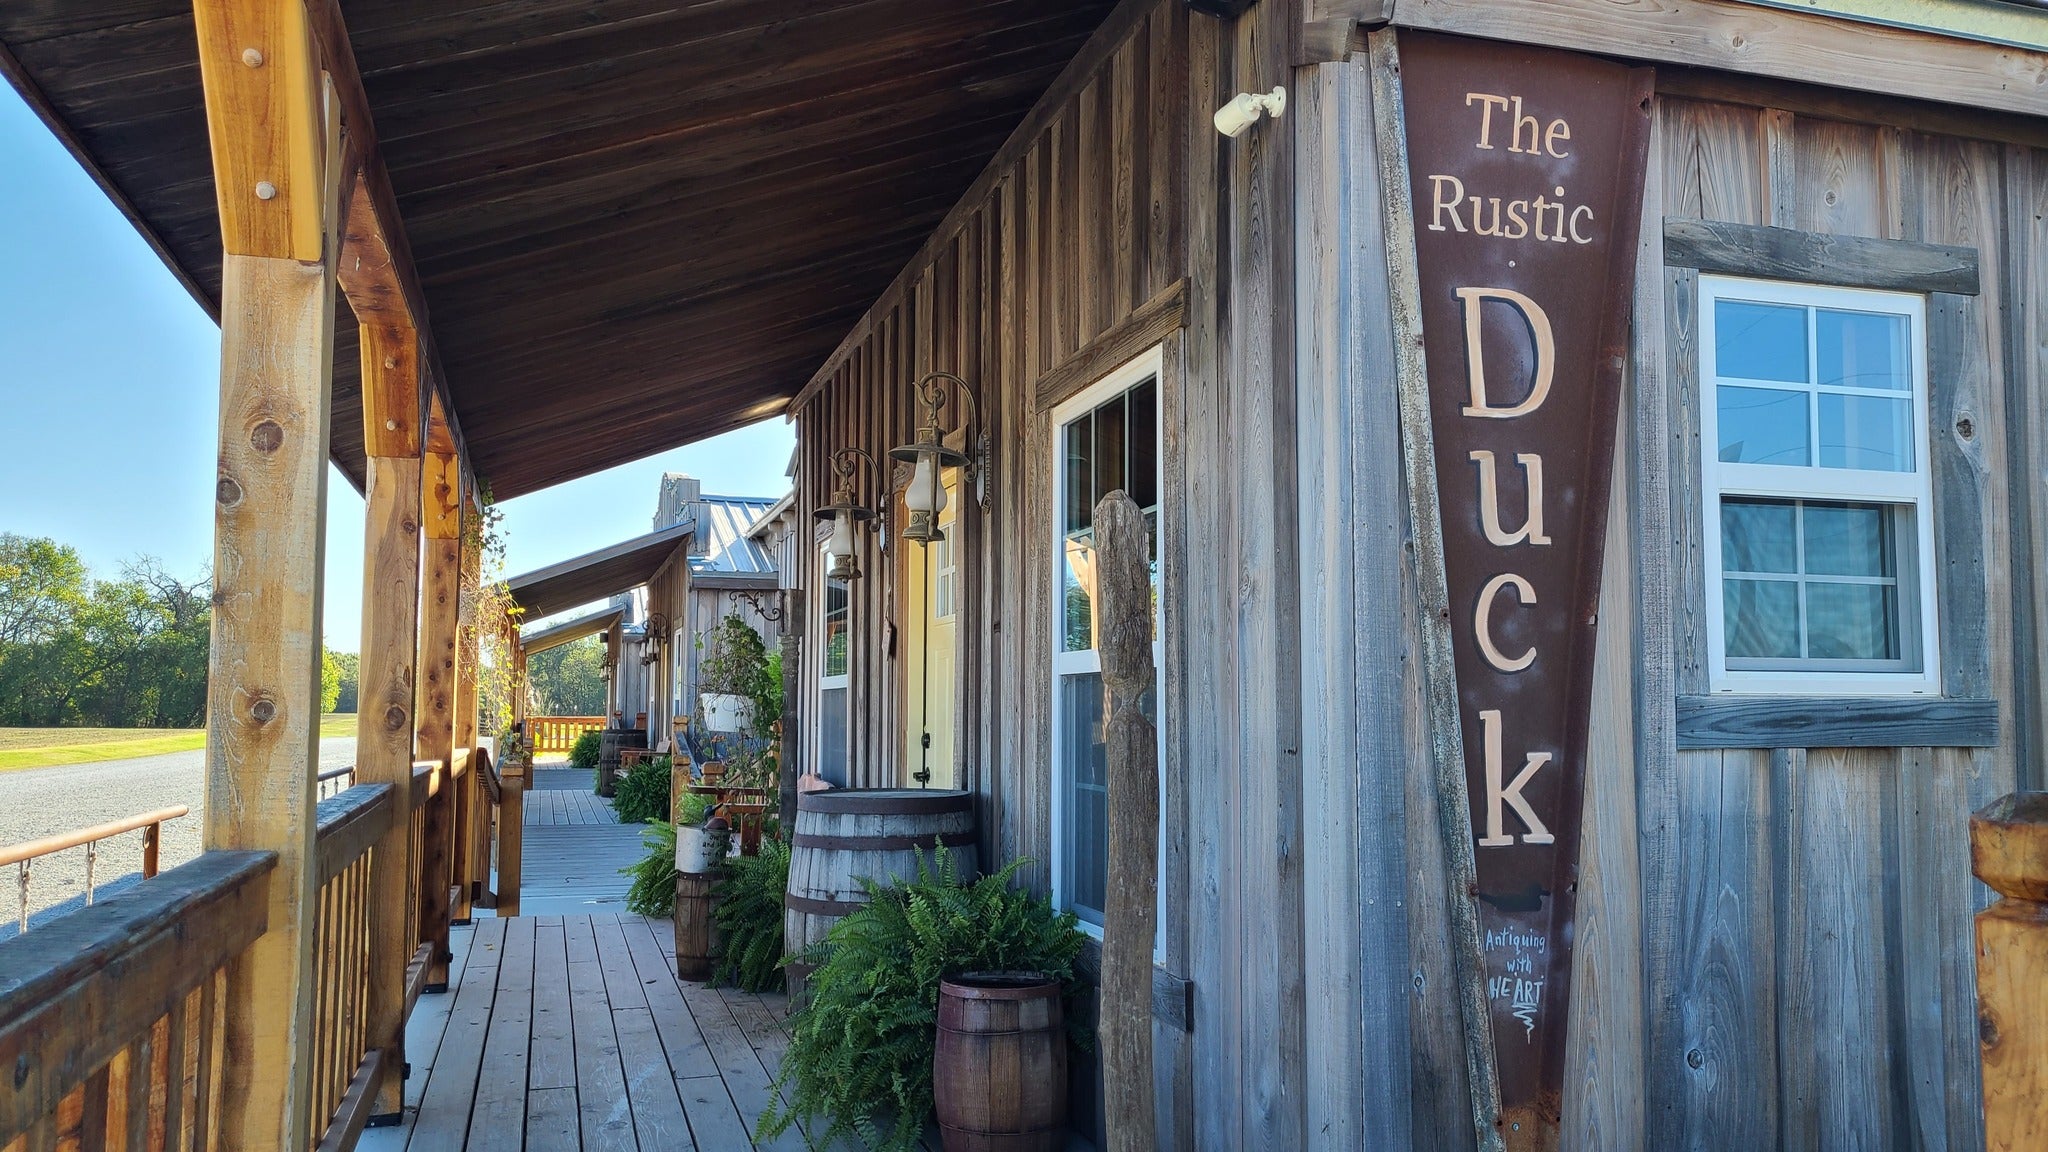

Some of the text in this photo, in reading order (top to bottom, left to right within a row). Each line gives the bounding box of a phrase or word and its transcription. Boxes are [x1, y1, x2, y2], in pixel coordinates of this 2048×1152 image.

[1466, 92, 1571, 159] The
[1428, 174, 1594, 244] Rustic
[1452, 286, 1555, 847] Duck
[1485, 925, 1545, 955] Antiquing
[1506, 953, 1532, 974] with
[1488, 976, 1544, 1004] HEART
